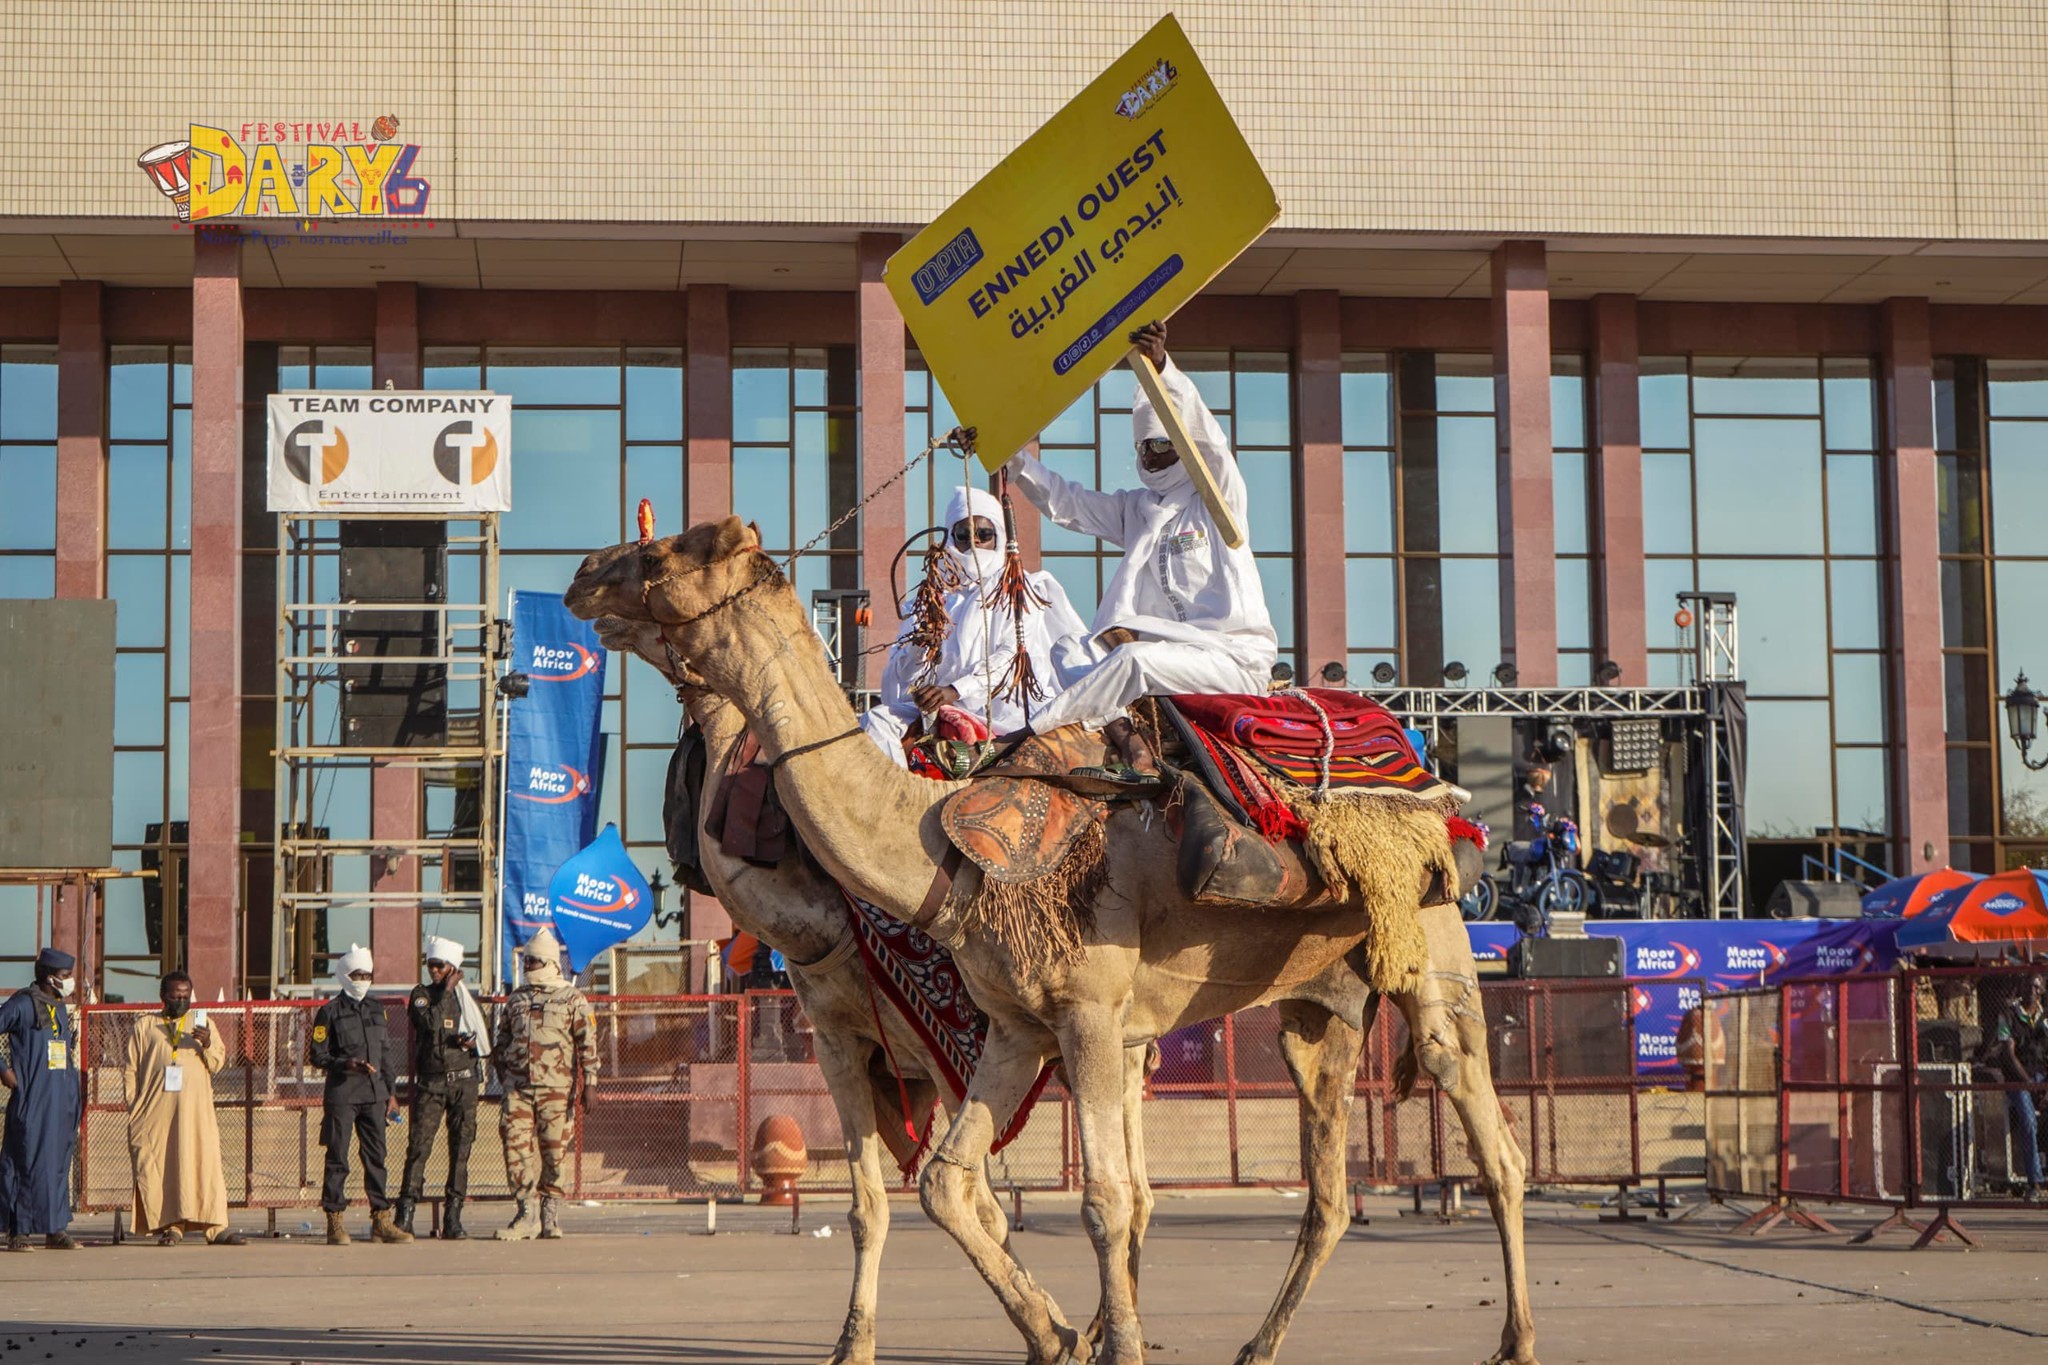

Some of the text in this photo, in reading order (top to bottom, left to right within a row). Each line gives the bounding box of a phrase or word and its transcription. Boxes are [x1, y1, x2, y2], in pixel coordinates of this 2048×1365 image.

[968, 215, 1075, 319] ENNEDI
[1077, 128, 1167, 221] OUEST
[1008, 248, 1096, 339] الغربية
[288, 398, 495, 414] TEAM COMPANY
[318, 490, 462, 500] Entertainment
[533, 645, 574, 659] Moov
[532, 657, 573, 670] Africa
[530, 767, 566, 782] Moov
[529, 779, 565, 793] Africa
[577, 873, 615, 892] Moov
[524, 893, 549, 905] Mo
[574, 884, 613, 903] Africa
[524, 904, 552, 916] Afri
[1637, 947, 1675, 959] Moov
[1727, 946, 1765, 958] Moov
[1817, 945, 1853, 956] Moov
[1637, 958, 1676, 970] Africa
[1727, 956, 1766, 969] Africa
[1816, 957, 1853, 967] Africa
[1639, 1033, 1677, 1044] Moov
